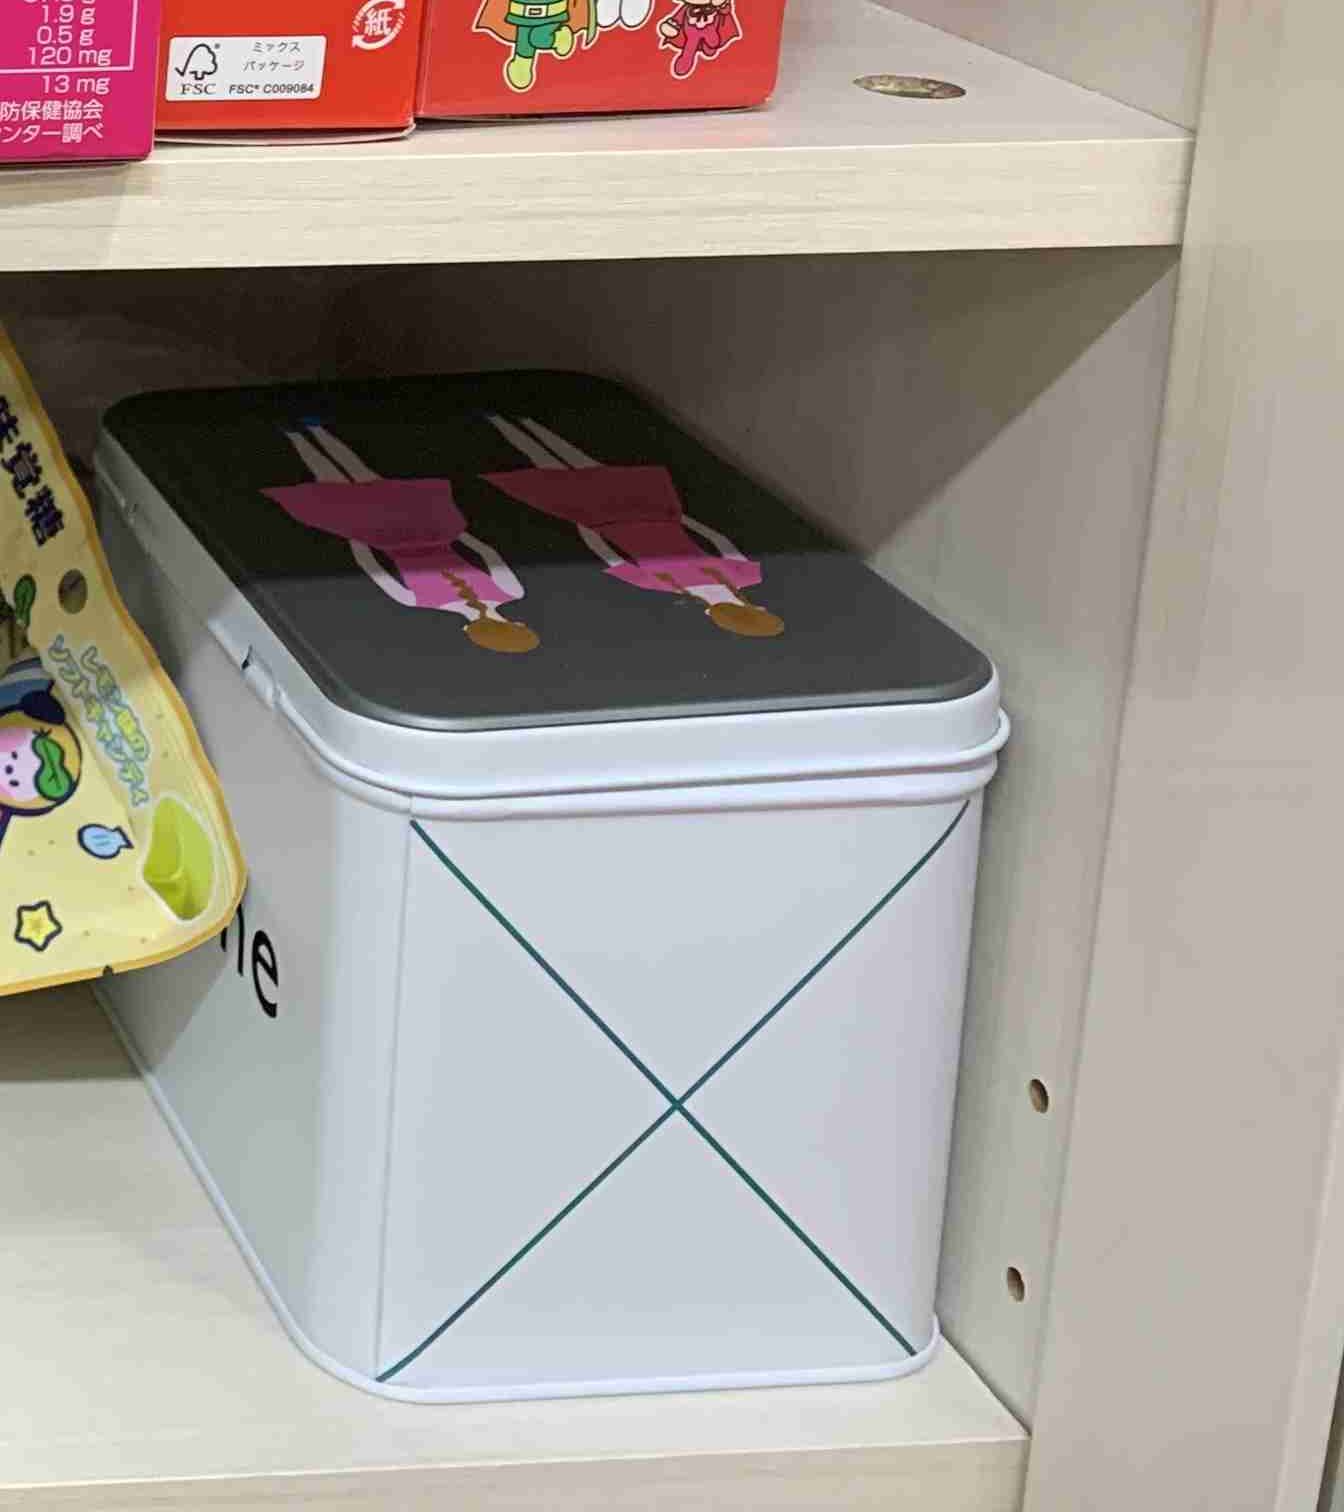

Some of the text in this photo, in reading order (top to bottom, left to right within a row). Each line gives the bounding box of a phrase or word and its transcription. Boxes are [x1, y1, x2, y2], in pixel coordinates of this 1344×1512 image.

[41, 6, 75, 23] 1.9
[80, 8, 95, 28] g
[364, 10, 393, 37] 紙
[38, 27, 74, 45] 0.5
[79, 29, 94, 48] g
[25, 48, 72, 66] 120
[77, 49, 112, 69] mg
[42, 76, 111, 97] 13 mg
[179, 82, 217, 96] FSC
